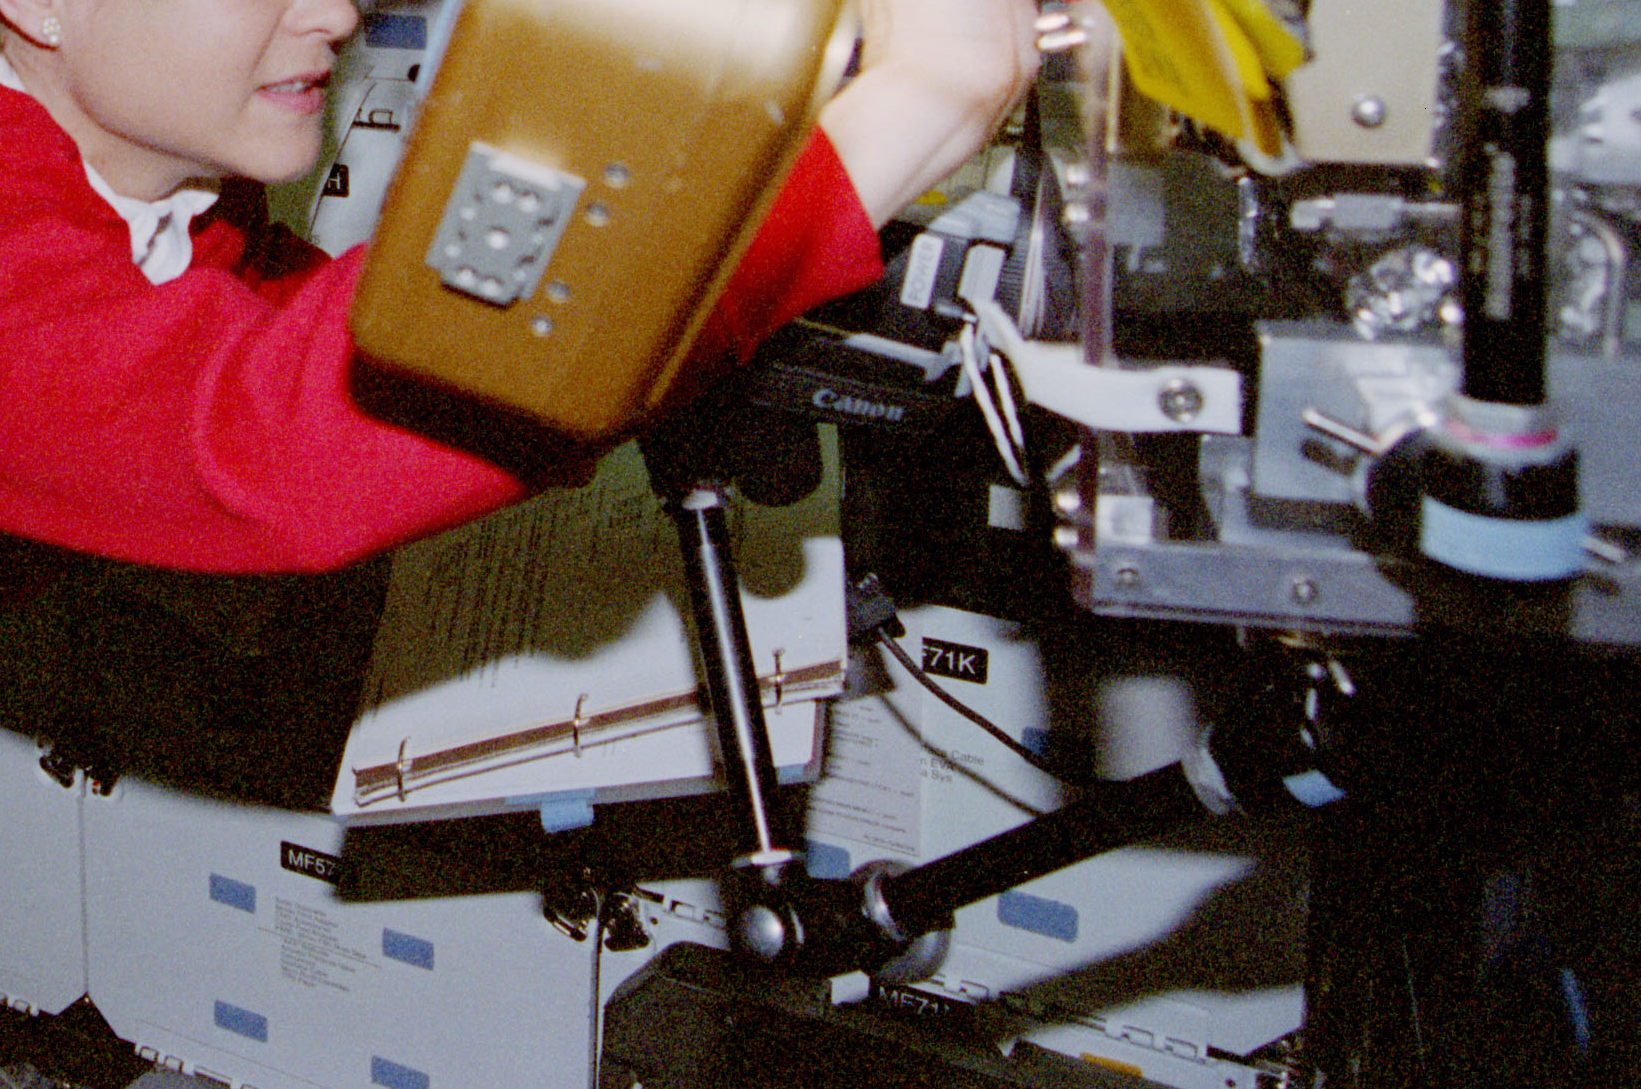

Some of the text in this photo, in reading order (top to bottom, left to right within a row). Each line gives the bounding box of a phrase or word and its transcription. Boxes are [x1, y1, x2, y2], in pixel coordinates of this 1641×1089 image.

[908, 241, 934, 301] POWER
[812, 389, 904, 422] Canon
[951, 749, 985, 765] Cable
[288, 848, 337, 877] MF57
